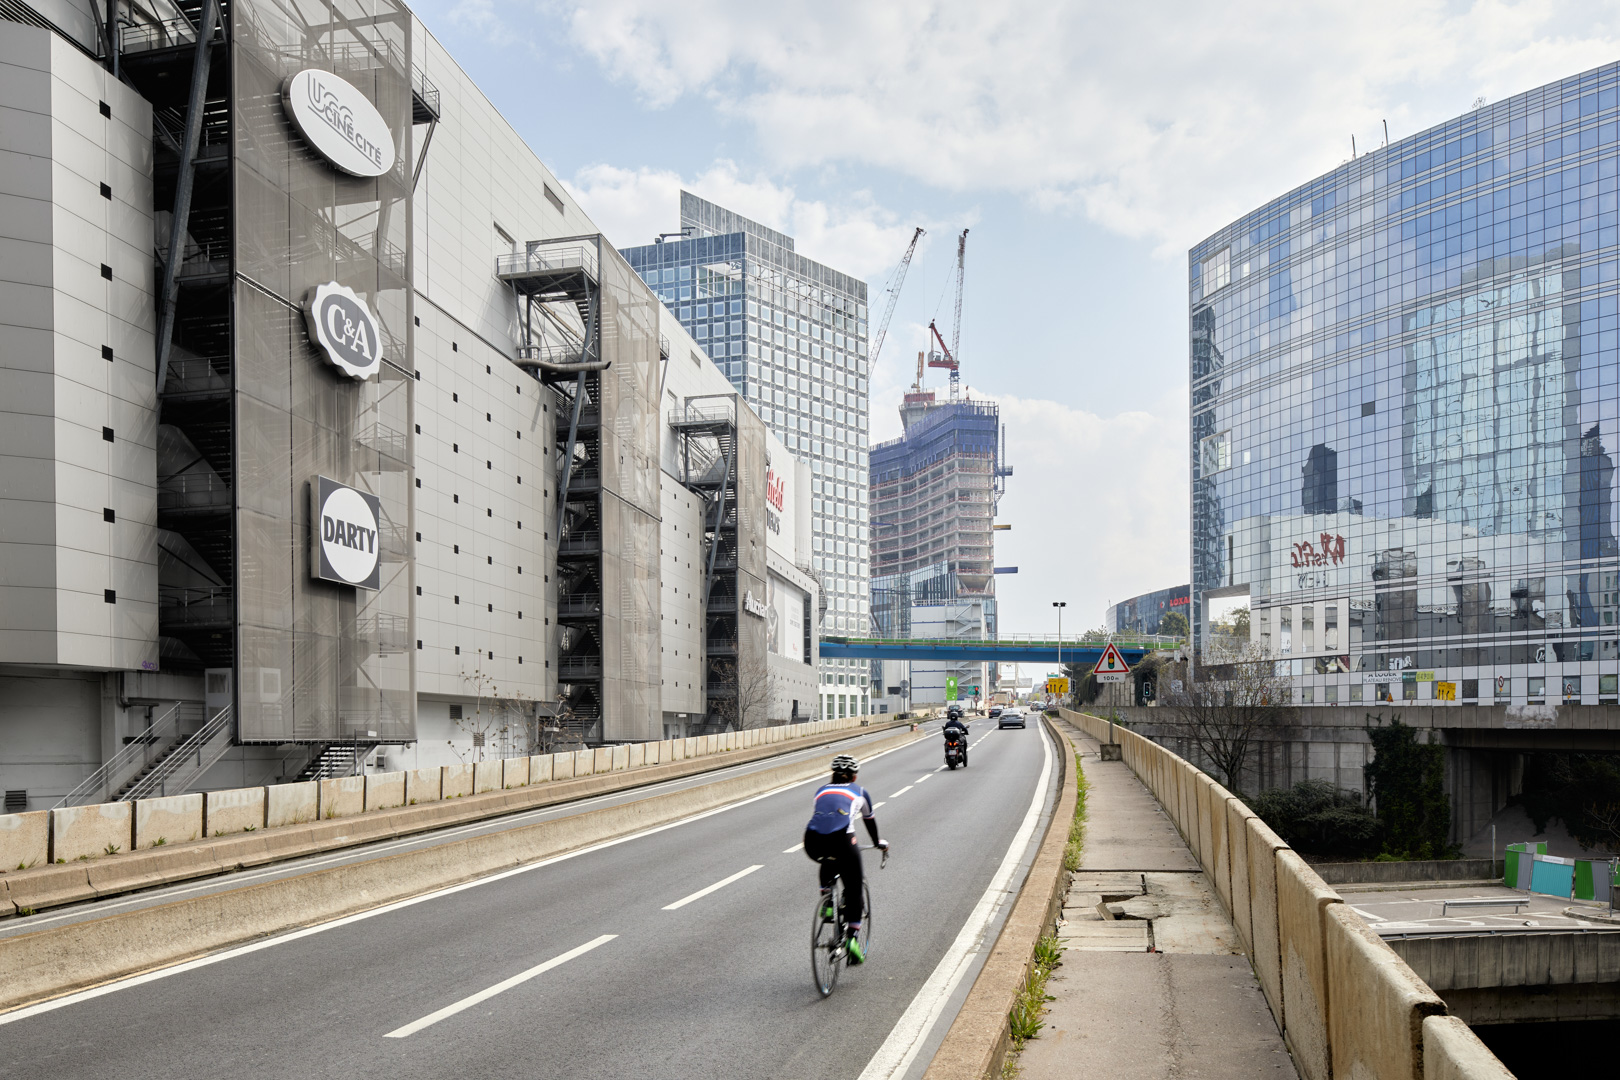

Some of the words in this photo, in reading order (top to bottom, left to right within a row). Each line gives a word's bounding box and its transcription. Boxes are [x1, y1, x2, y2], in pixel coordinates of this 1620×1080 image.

[325, 105, 354, 142] CINÉ
[355, 132, 381, 165] CITÉ
[327, 304, 373, 360] C&A
[323, 515, 376, 554] DARTY
